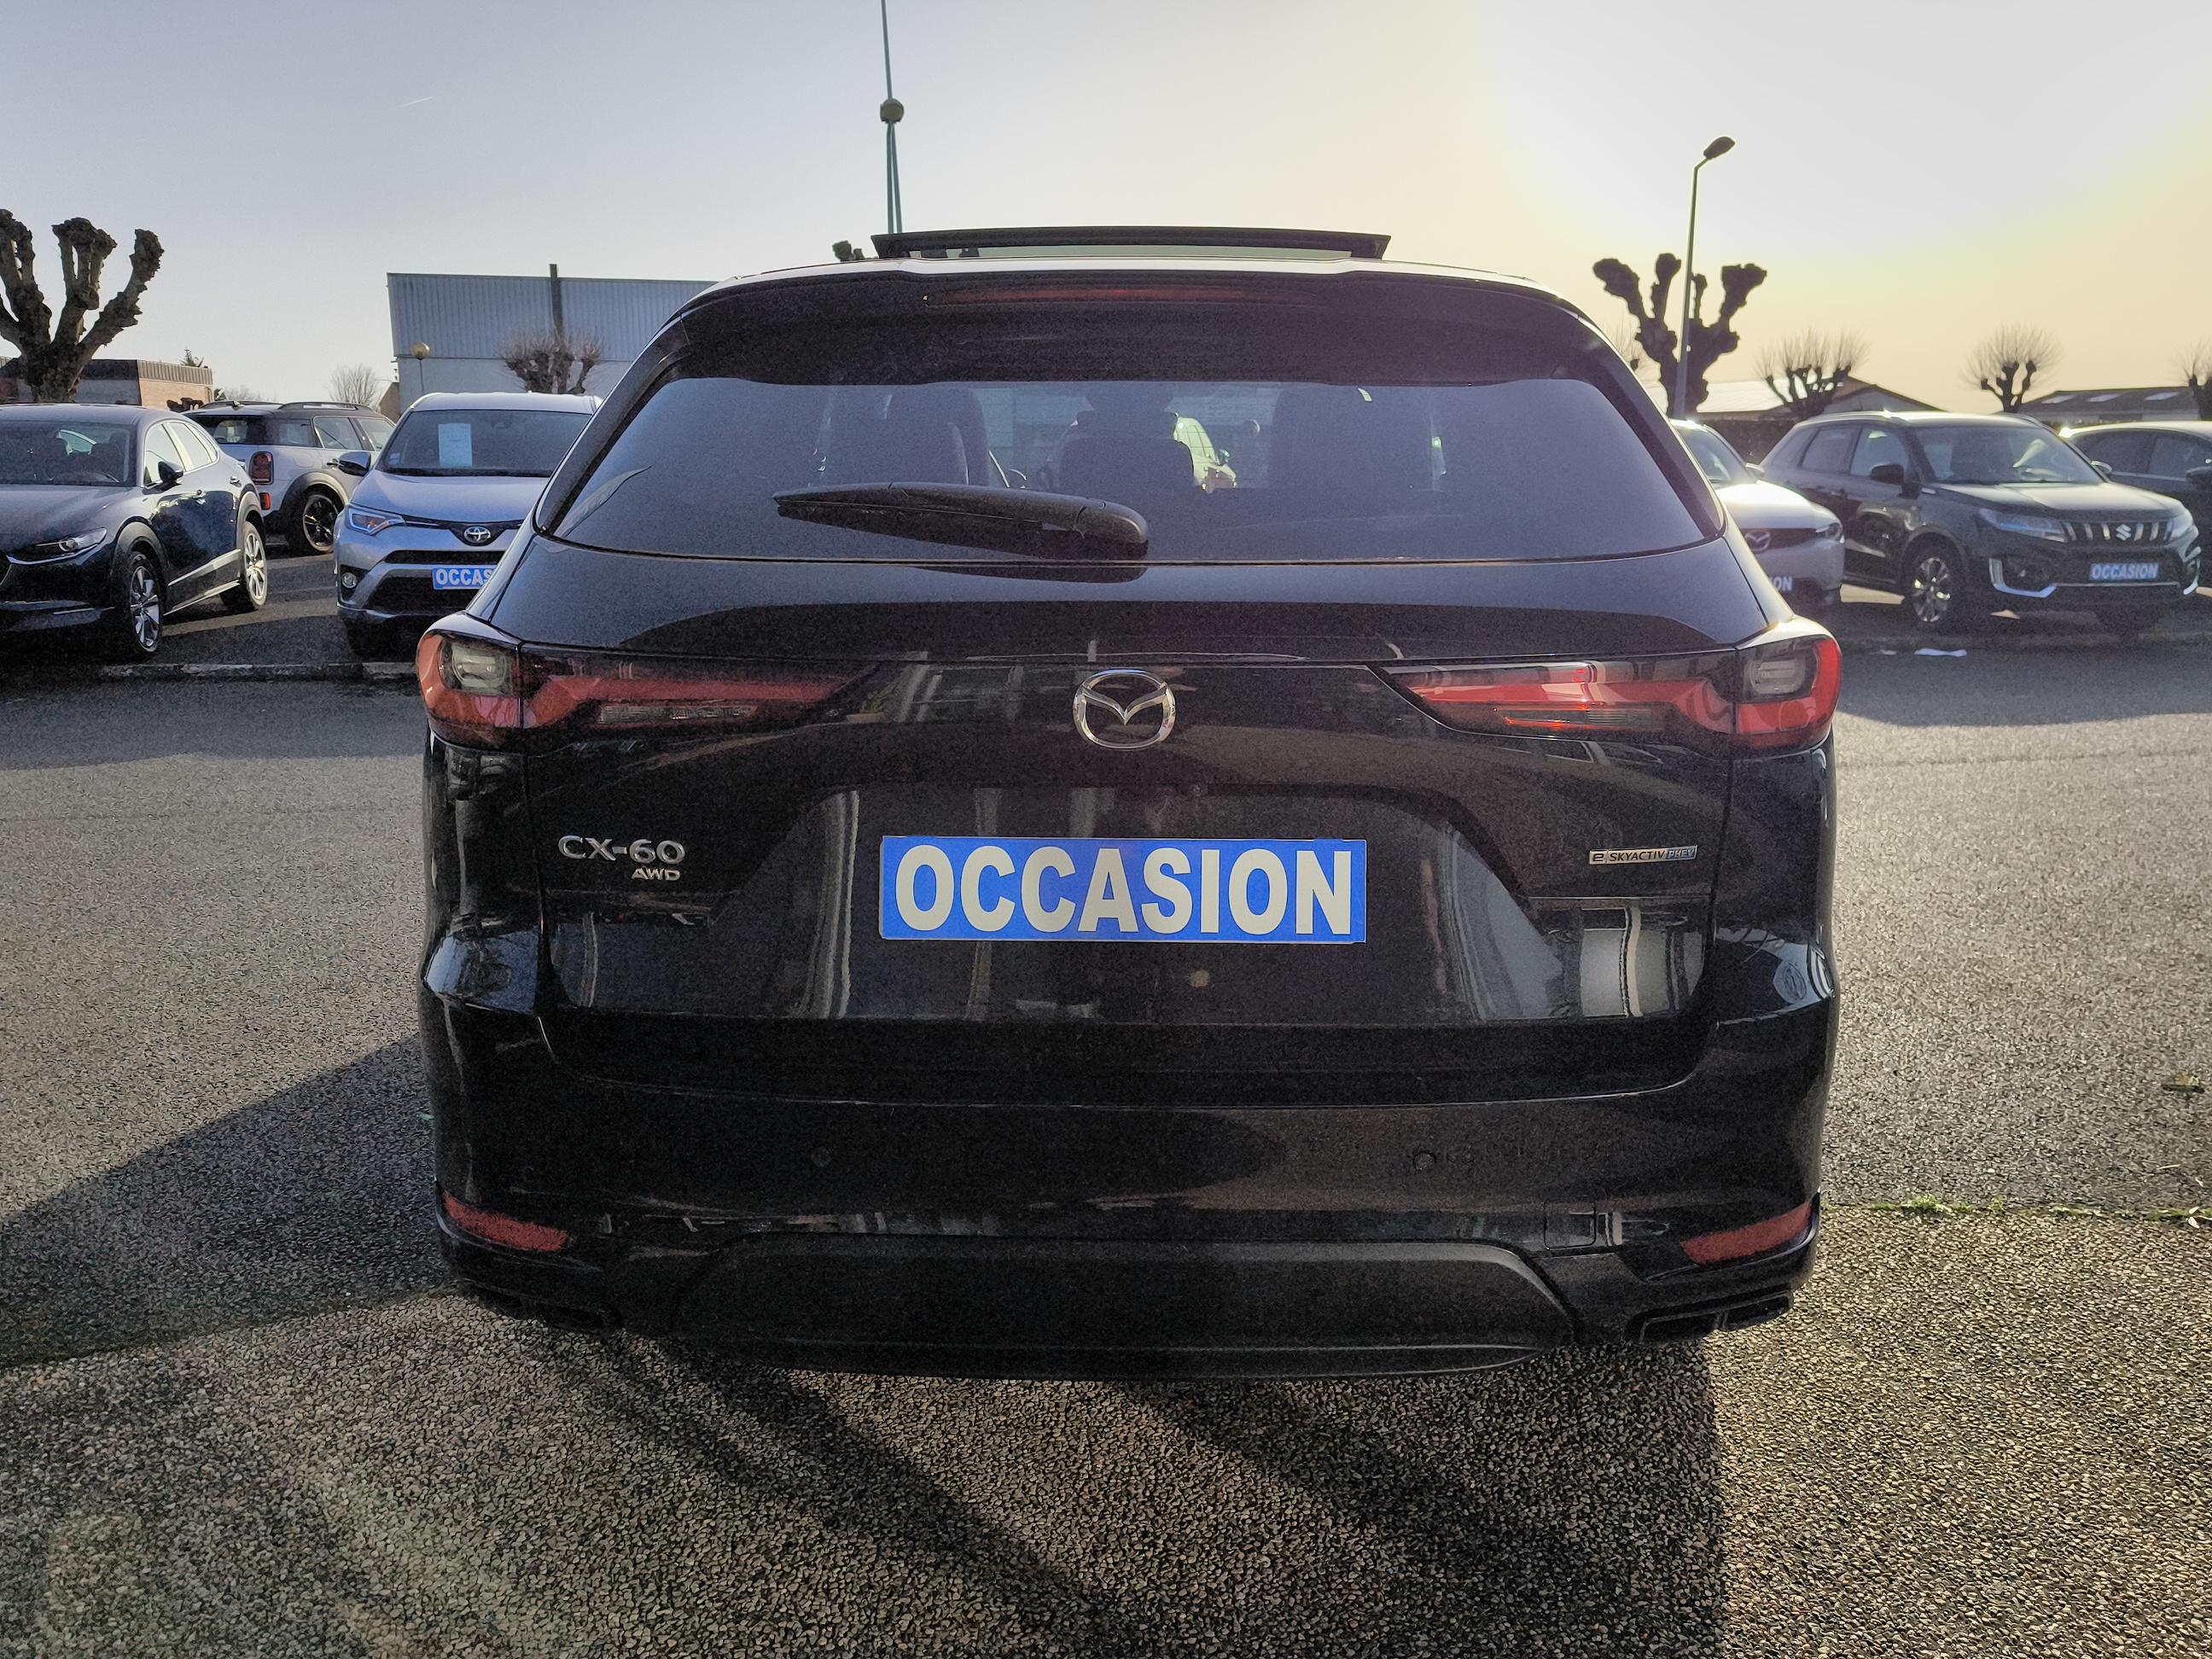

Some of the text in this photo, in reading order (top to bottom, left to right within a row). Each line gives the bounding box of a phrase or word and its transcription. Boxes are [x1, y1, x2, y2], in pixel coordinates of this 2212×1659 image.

[2091, 563, 2158, 579] OCCASION
[1771, 576, 1792, 591] ON
[557, 835, 685, 864] CX-60
[1610, 851, 1666, 862] SKYACTIV
[1667, 848, 1695, 859] PHEV
[632, 867, 681, 881] AWD
[895, 845, 1352, 934] OCCASION
